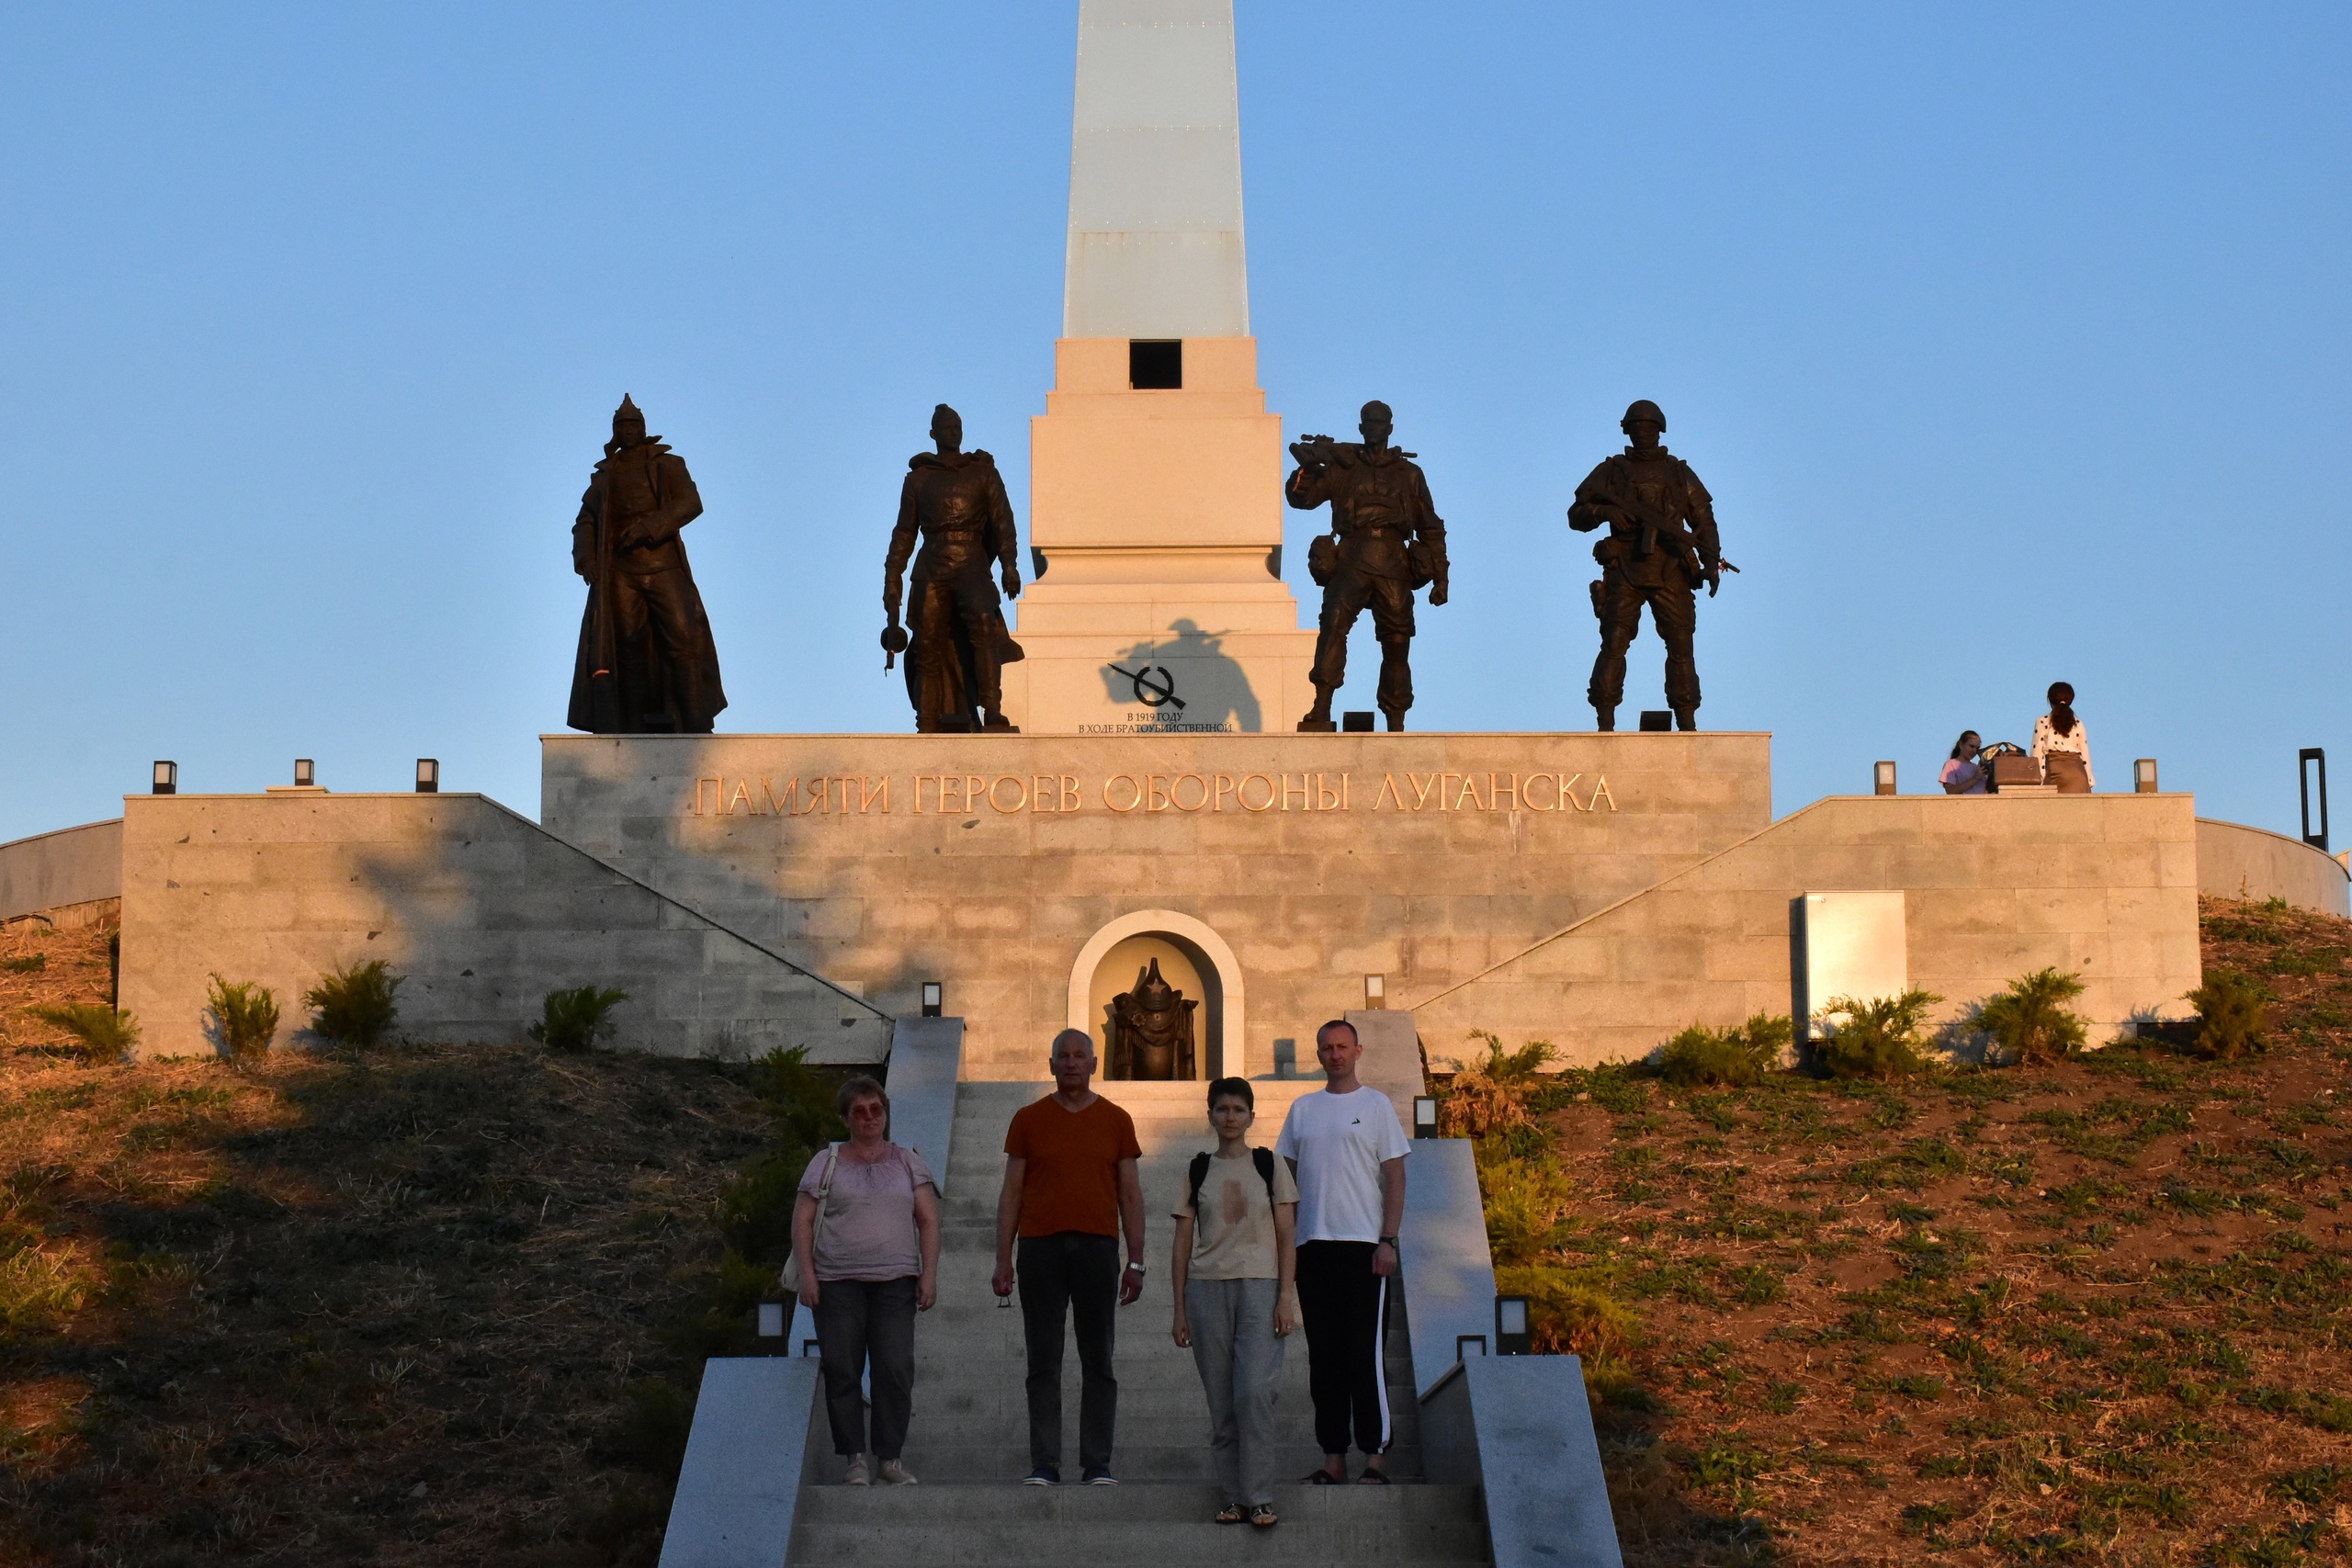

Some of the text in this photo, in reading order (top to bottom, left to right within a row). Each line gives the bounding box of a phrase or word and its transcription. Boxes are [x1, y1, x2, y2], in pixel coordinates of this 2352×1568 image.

[1127, 712, 1184, 723] В 1919 ГОДУ
[1079, 722, 1233, 734] В ХОДЕ БРАТОУБИЙСТВЕННОЙ
[694, 773, 1619, 816] ПАМЯТИ ГЕРОЕВ ОБОРОНЫ ЛУГАНСКА
